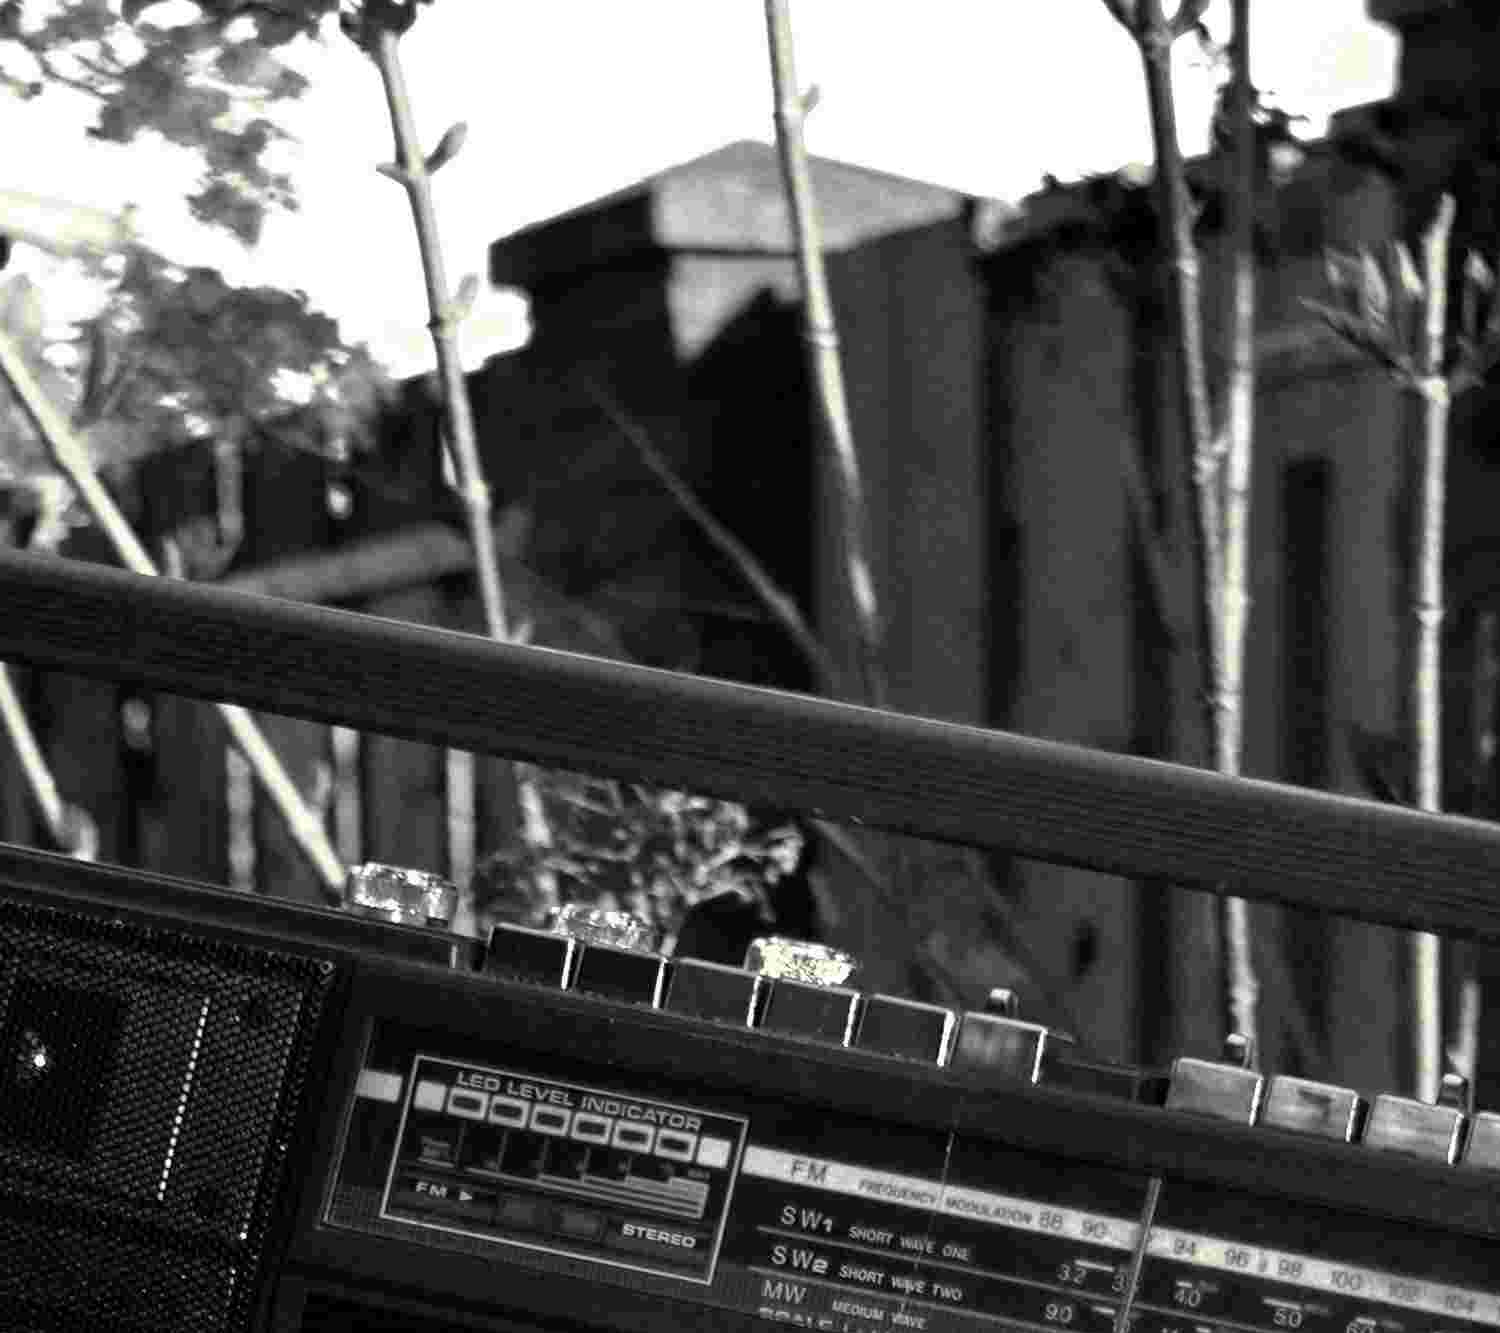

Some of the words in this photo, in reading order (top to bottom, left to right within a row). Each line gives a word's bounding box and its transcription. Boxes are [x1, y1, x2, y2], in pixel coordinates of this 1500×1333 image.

[456, 1071, 501, 1093] LED
[506, 1080, 574, 1107] LEVEL
[580, 1094, 702, 1131] INDICATOR
[415, 1181, 448, 1200] FM
[790, 1159, 828, 1184] FM
[858, 1179, 937, 1207] FREQUENCY
[1038, 1209, 1065, 1232] 88
[1081, 1218, 1108, 1240] 90
[622, 1223, 697, 1249] STEREO
[780, 1204, 834, 1233] SW1
[848, 1224, 894, 1246] SHORT
[899, 1234, 937, 1256] WAVE
[942, 1244, 971, 1262] ONE
[770, 1245, 830, 1275] SW2
[840, 1265, 885, 1286] SHORT
[892, 1275, 927, 1296] WAVE
[932, 1284, 964, 1303] TWO
[761, 1280, 807, 1304] MW
[832, 1298, 885, 1321] MEDIUM
[892, 1311, 929, 1331] WAVE
